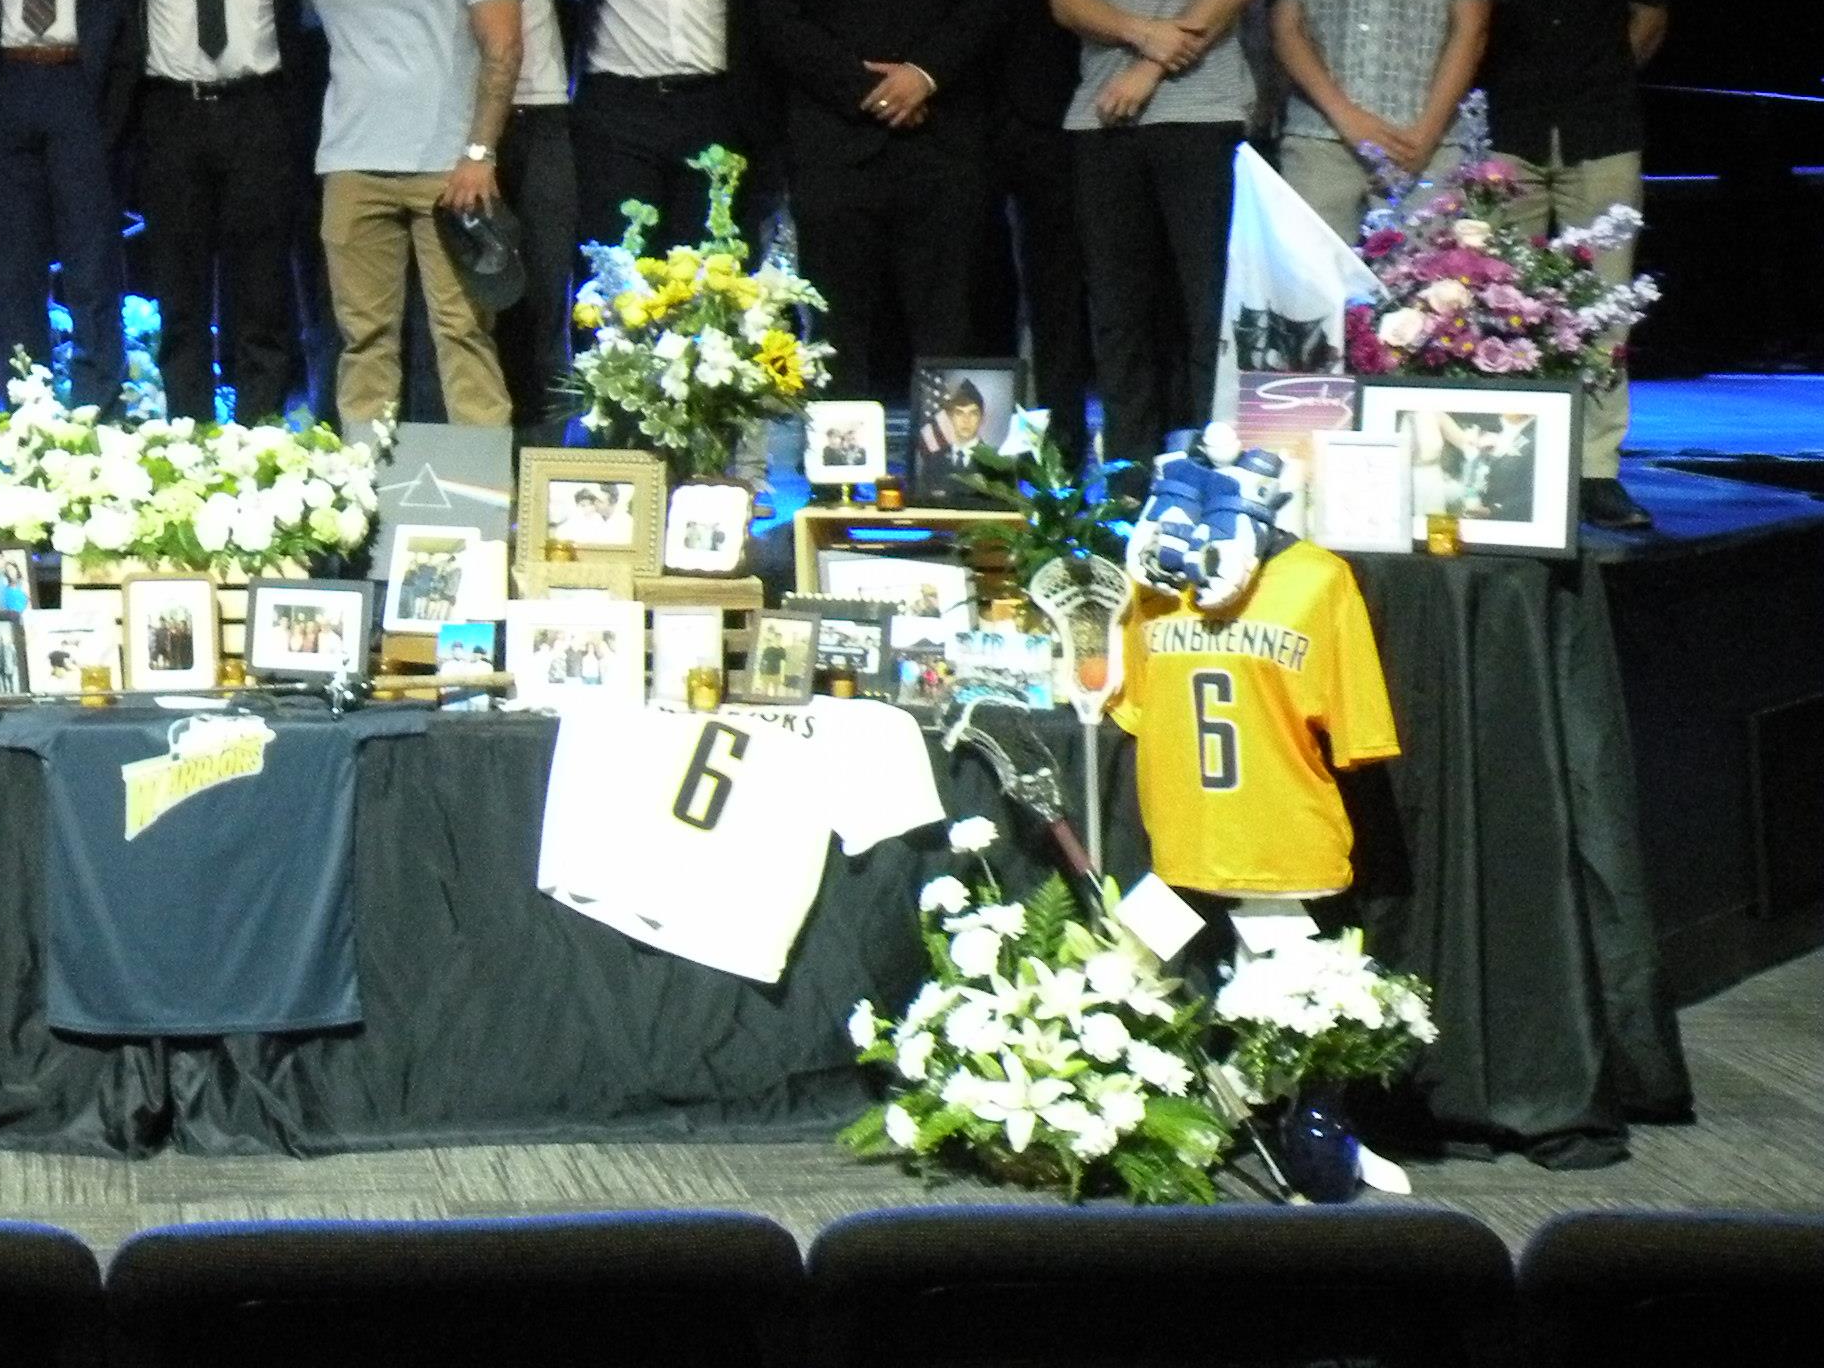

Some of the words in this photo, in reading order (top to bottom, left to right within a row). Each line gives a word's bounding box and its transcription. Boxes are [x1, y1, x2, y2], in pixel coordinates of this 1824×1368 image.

[1144, 619, 1309, 671] EINBRENNER
[673, 720, 750, 831] 6
[1192, 672, 1237, 788] 6
